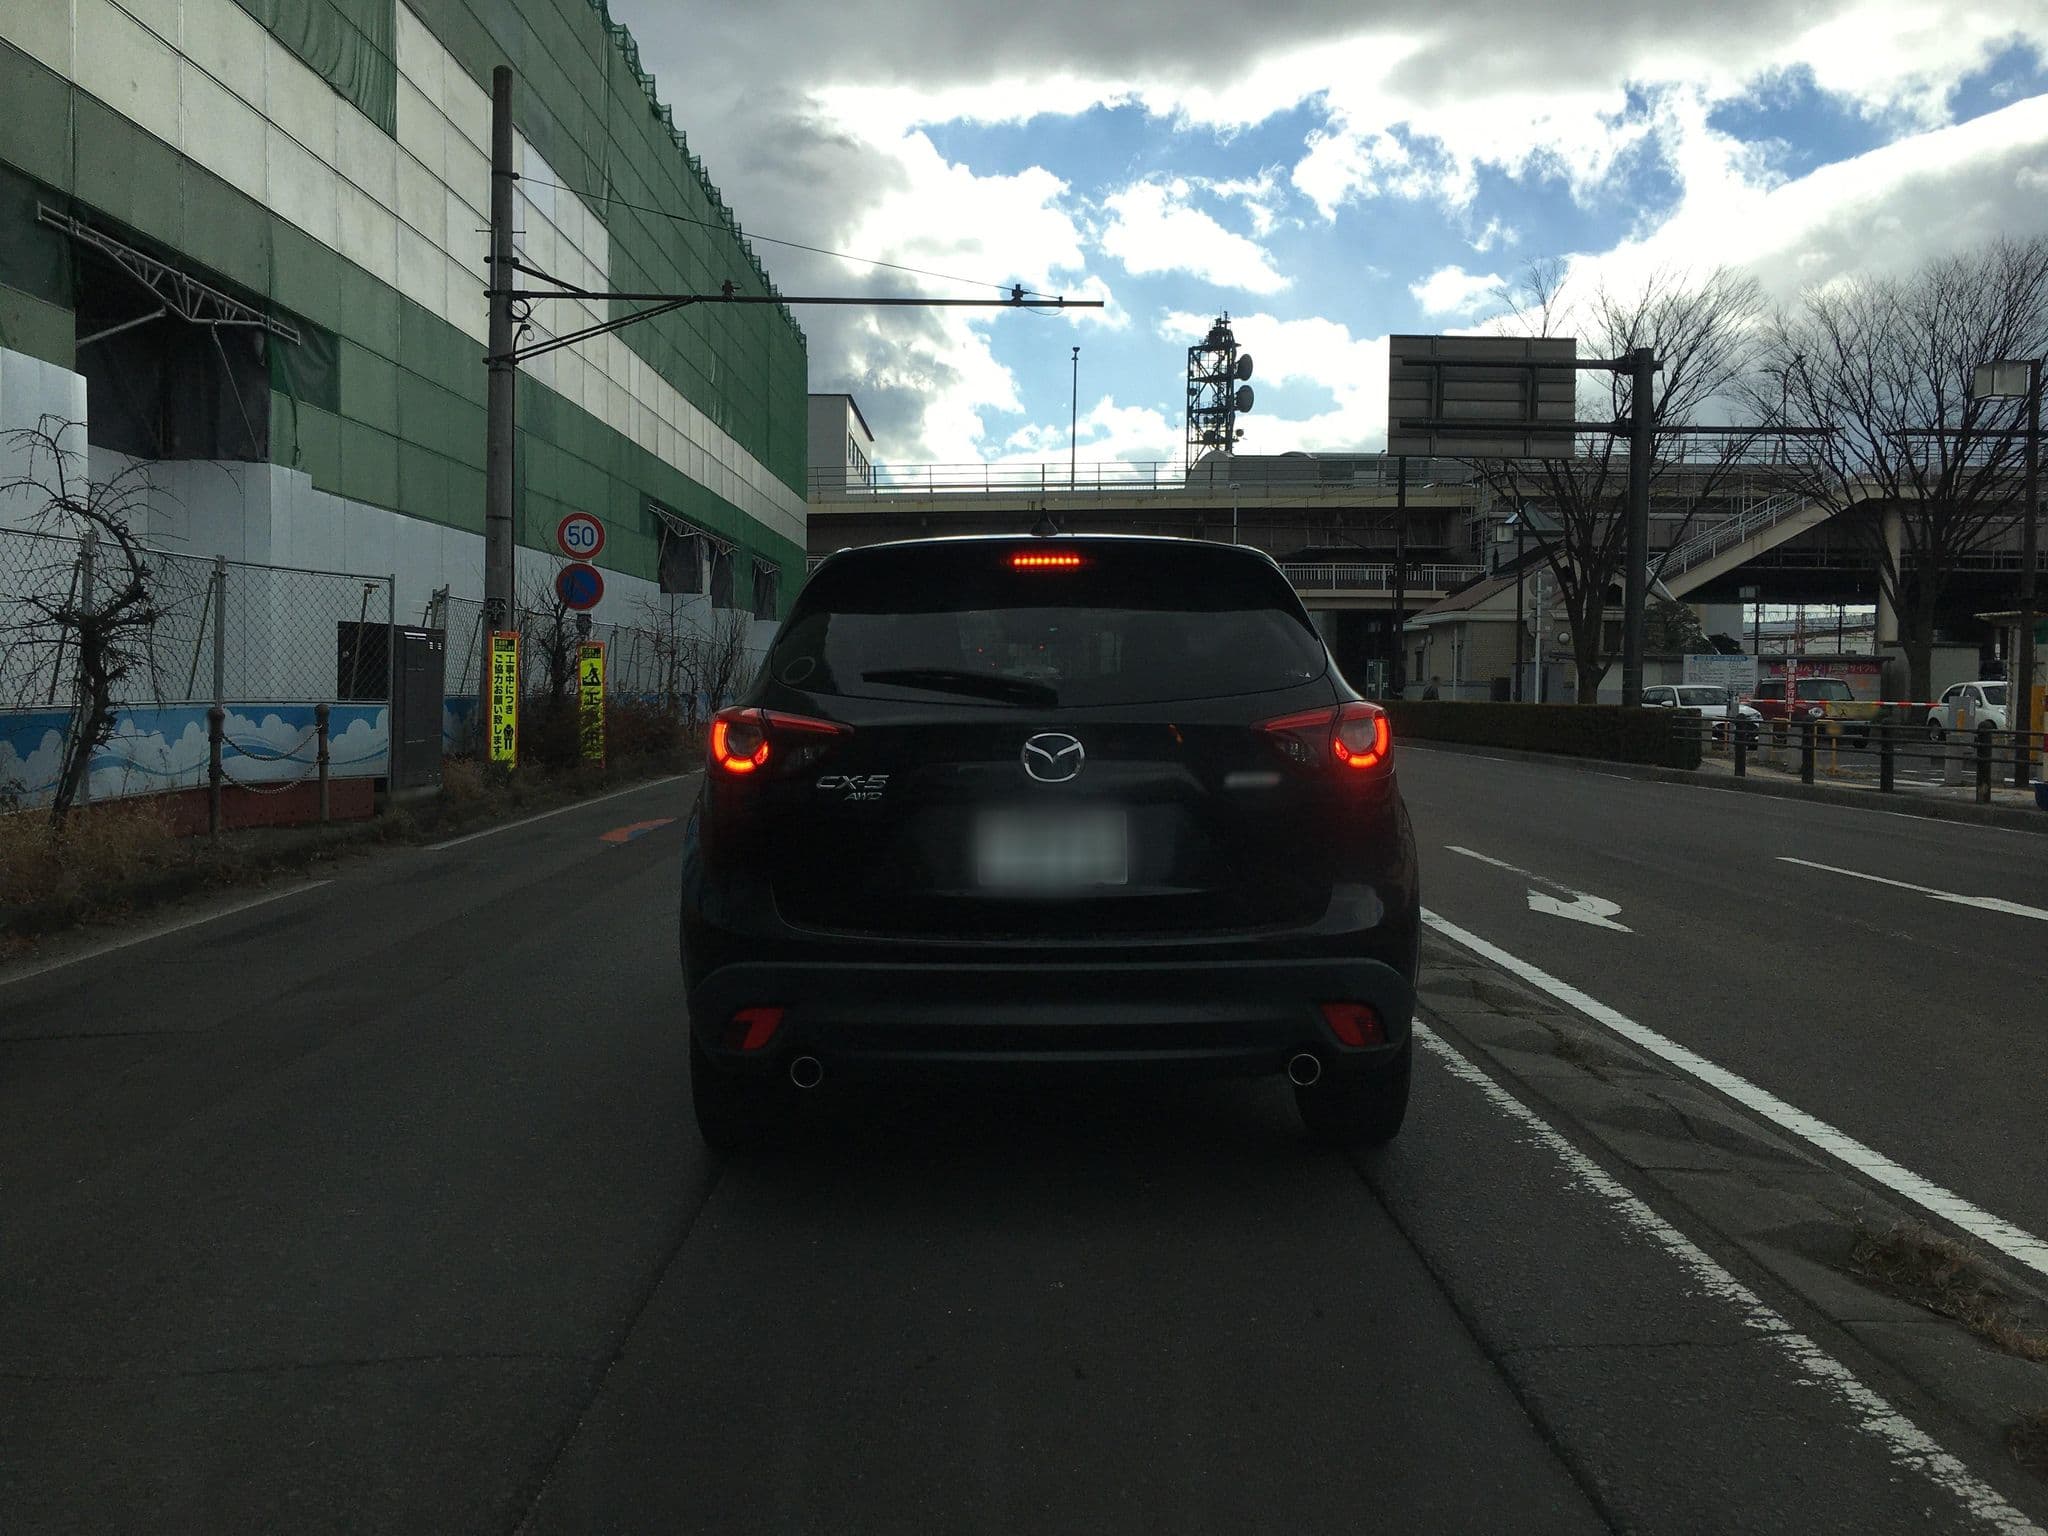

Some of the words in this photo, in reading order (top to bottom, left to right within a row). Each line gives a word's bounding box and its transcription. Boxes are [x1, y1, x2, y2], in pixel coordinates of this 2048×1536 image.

[568, 525, 595, 547] 50
[505, 654, 515, 715] 工事中につき
[493, 654, 503, 755] ご協力お願い致します
[816, 774, 890, 790] CX-5
[844, 791, 883, 801] AWD
